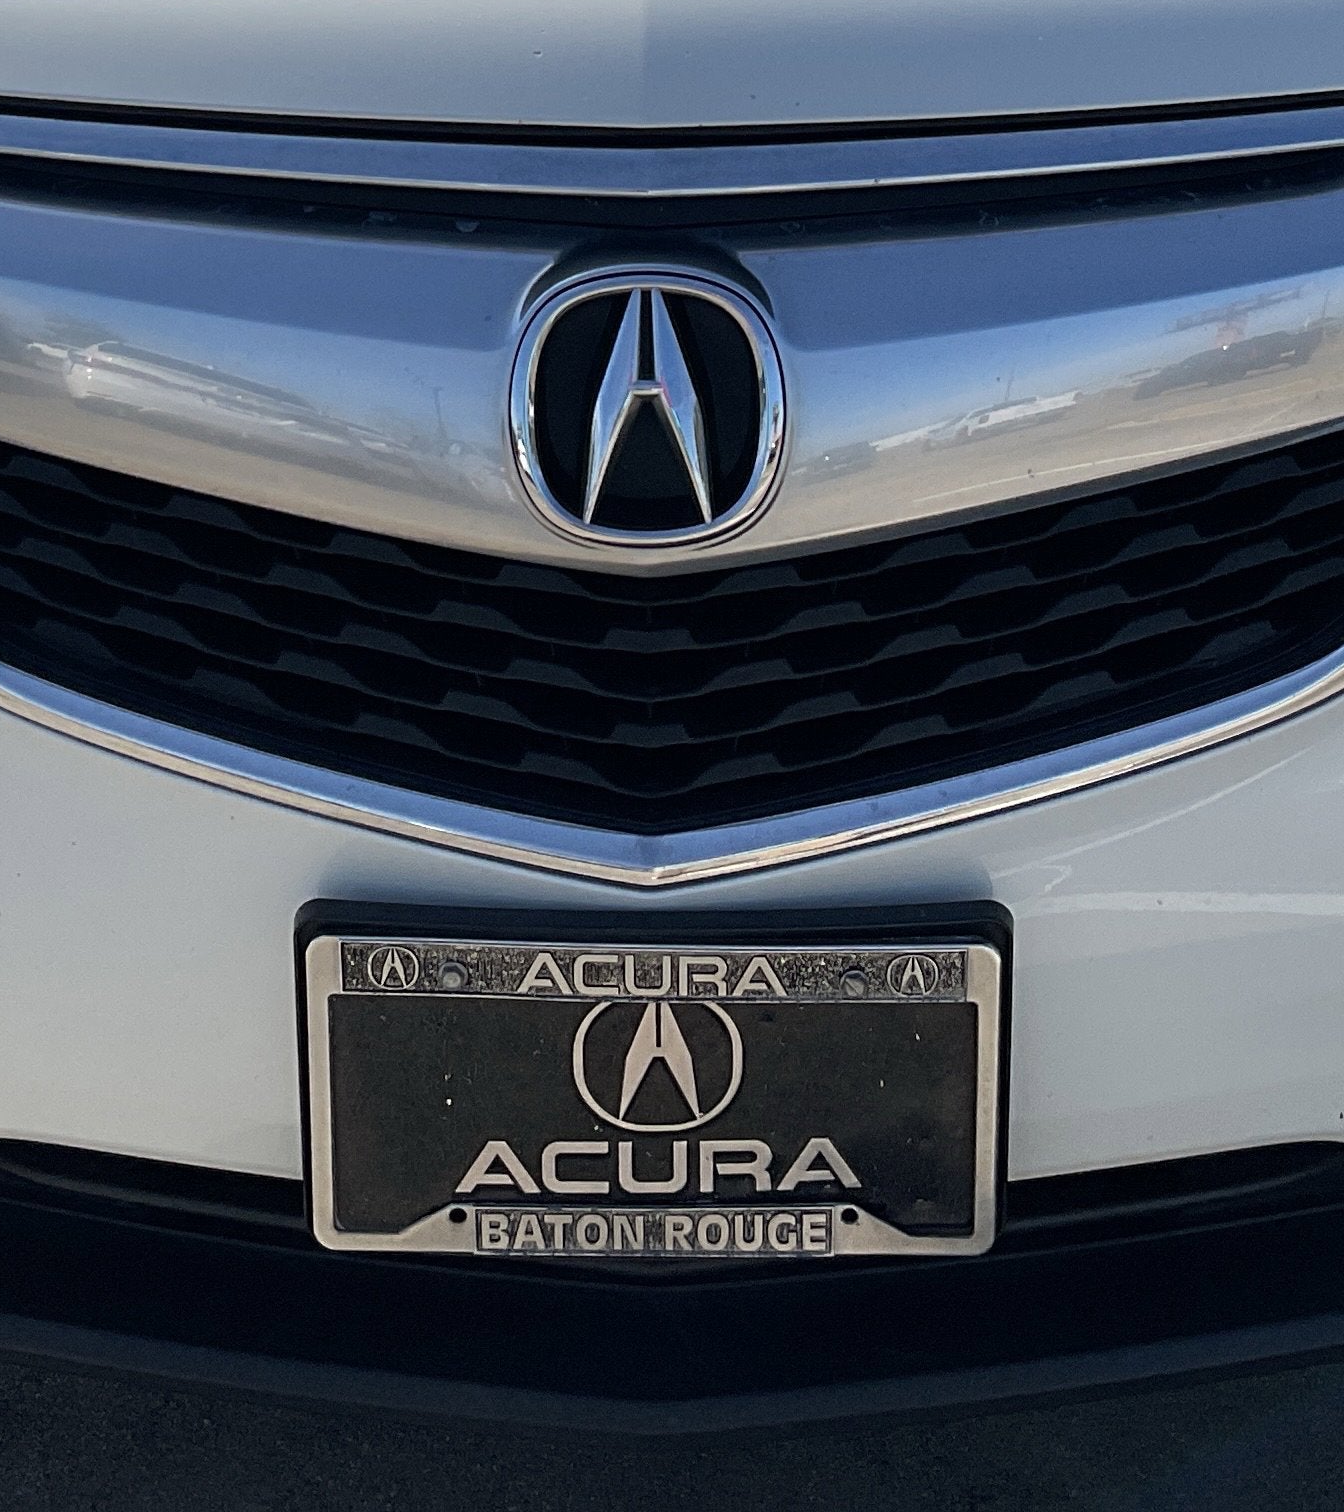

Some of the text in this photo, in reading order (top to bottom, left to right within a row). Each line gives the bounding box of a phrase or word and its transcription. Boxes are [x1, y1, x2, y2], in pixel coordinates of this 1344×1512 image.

[517, 951, 788, 997] ACURA
[455, 1137, 863, 1195] ACURA
[479, 1212, 828, 1252] BATON ROUGE
